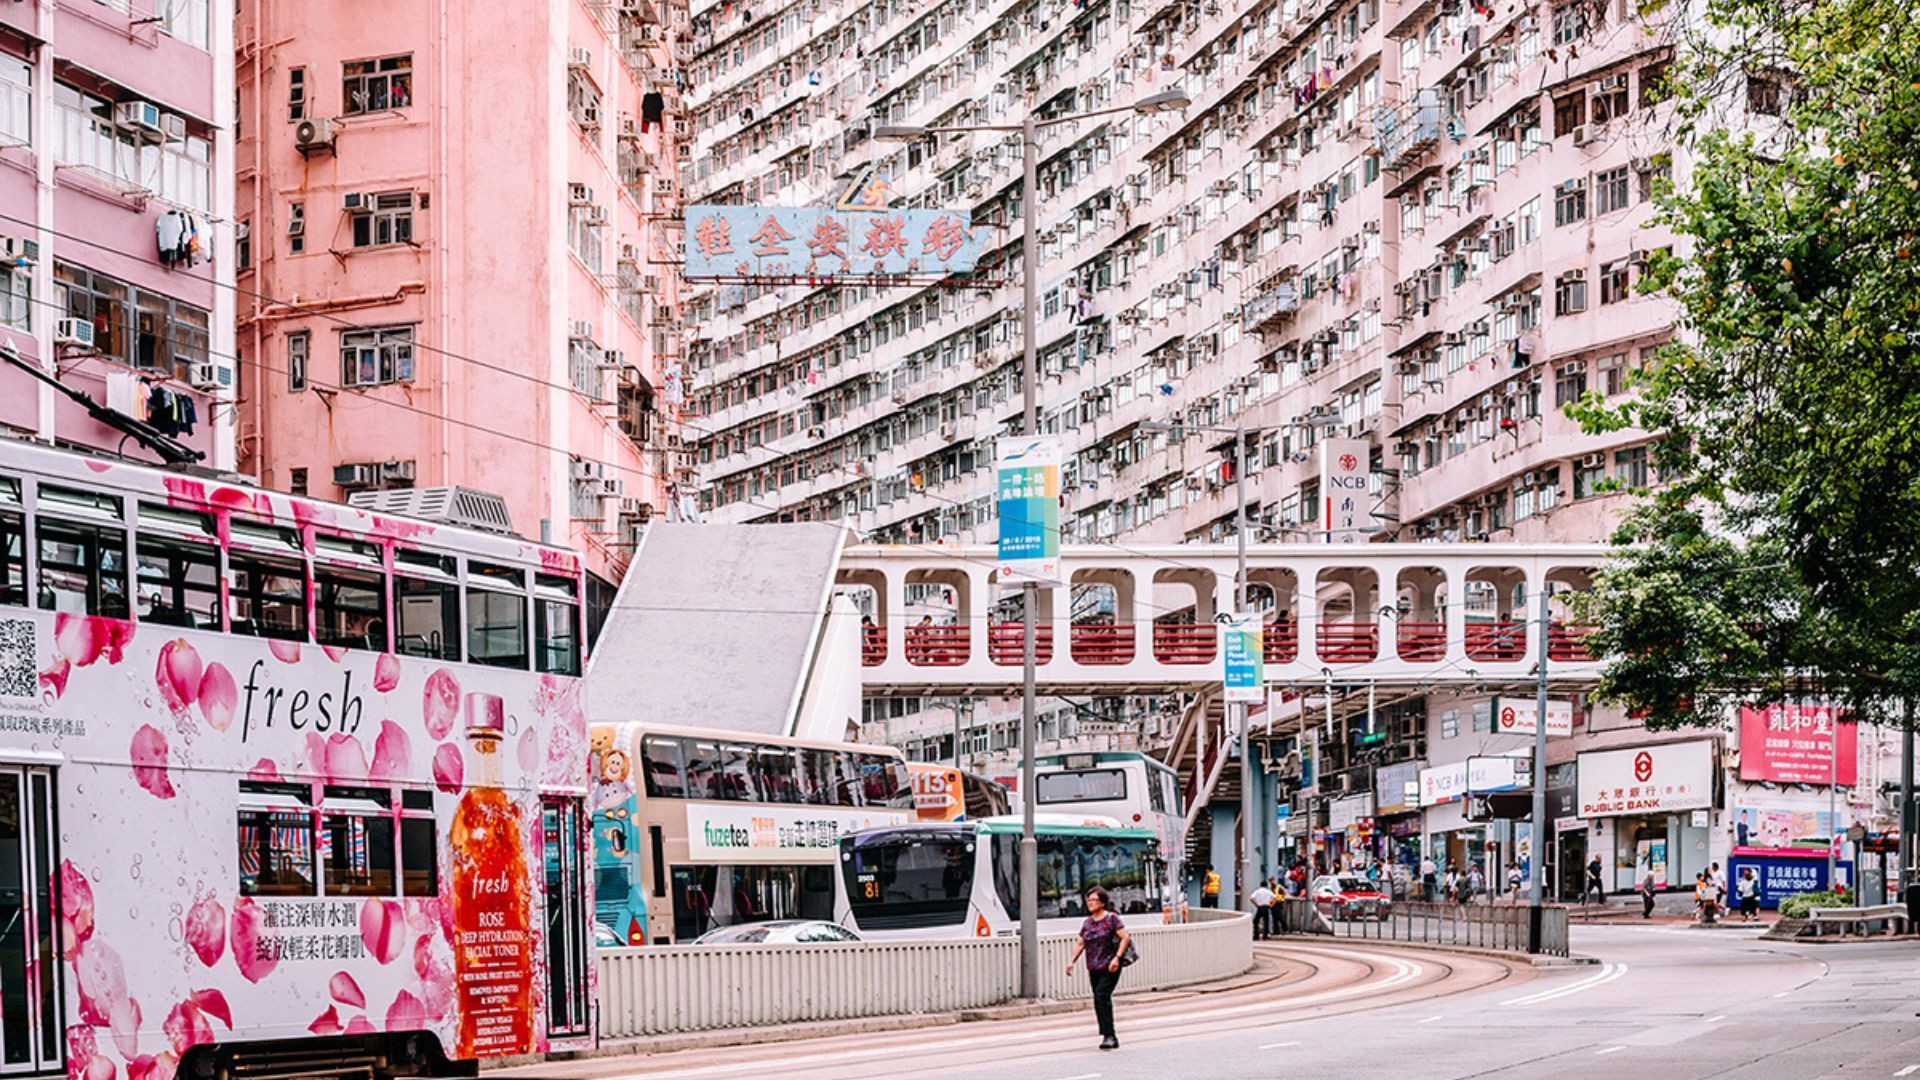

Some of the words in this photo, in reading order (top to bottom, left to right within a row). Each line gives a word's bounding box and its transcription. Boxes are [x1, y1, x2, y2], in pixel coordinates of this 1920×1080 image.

[1331, 476, 1366, 489] NCB
[242, 659, 362, 743] fresh
[1583, 803, 1625, 813] PUBLIC
[1626, 798, 1660, 810] BANK
[472, 870, 510, 900] fresh
[263, 902, 357, 928] 灌注深層水潤
[478, 911, 505, 928] ROSE
[256, 934, 366, 961] 綻放輕柔花瓣肌
[493, 944, 520, 956] TONER
